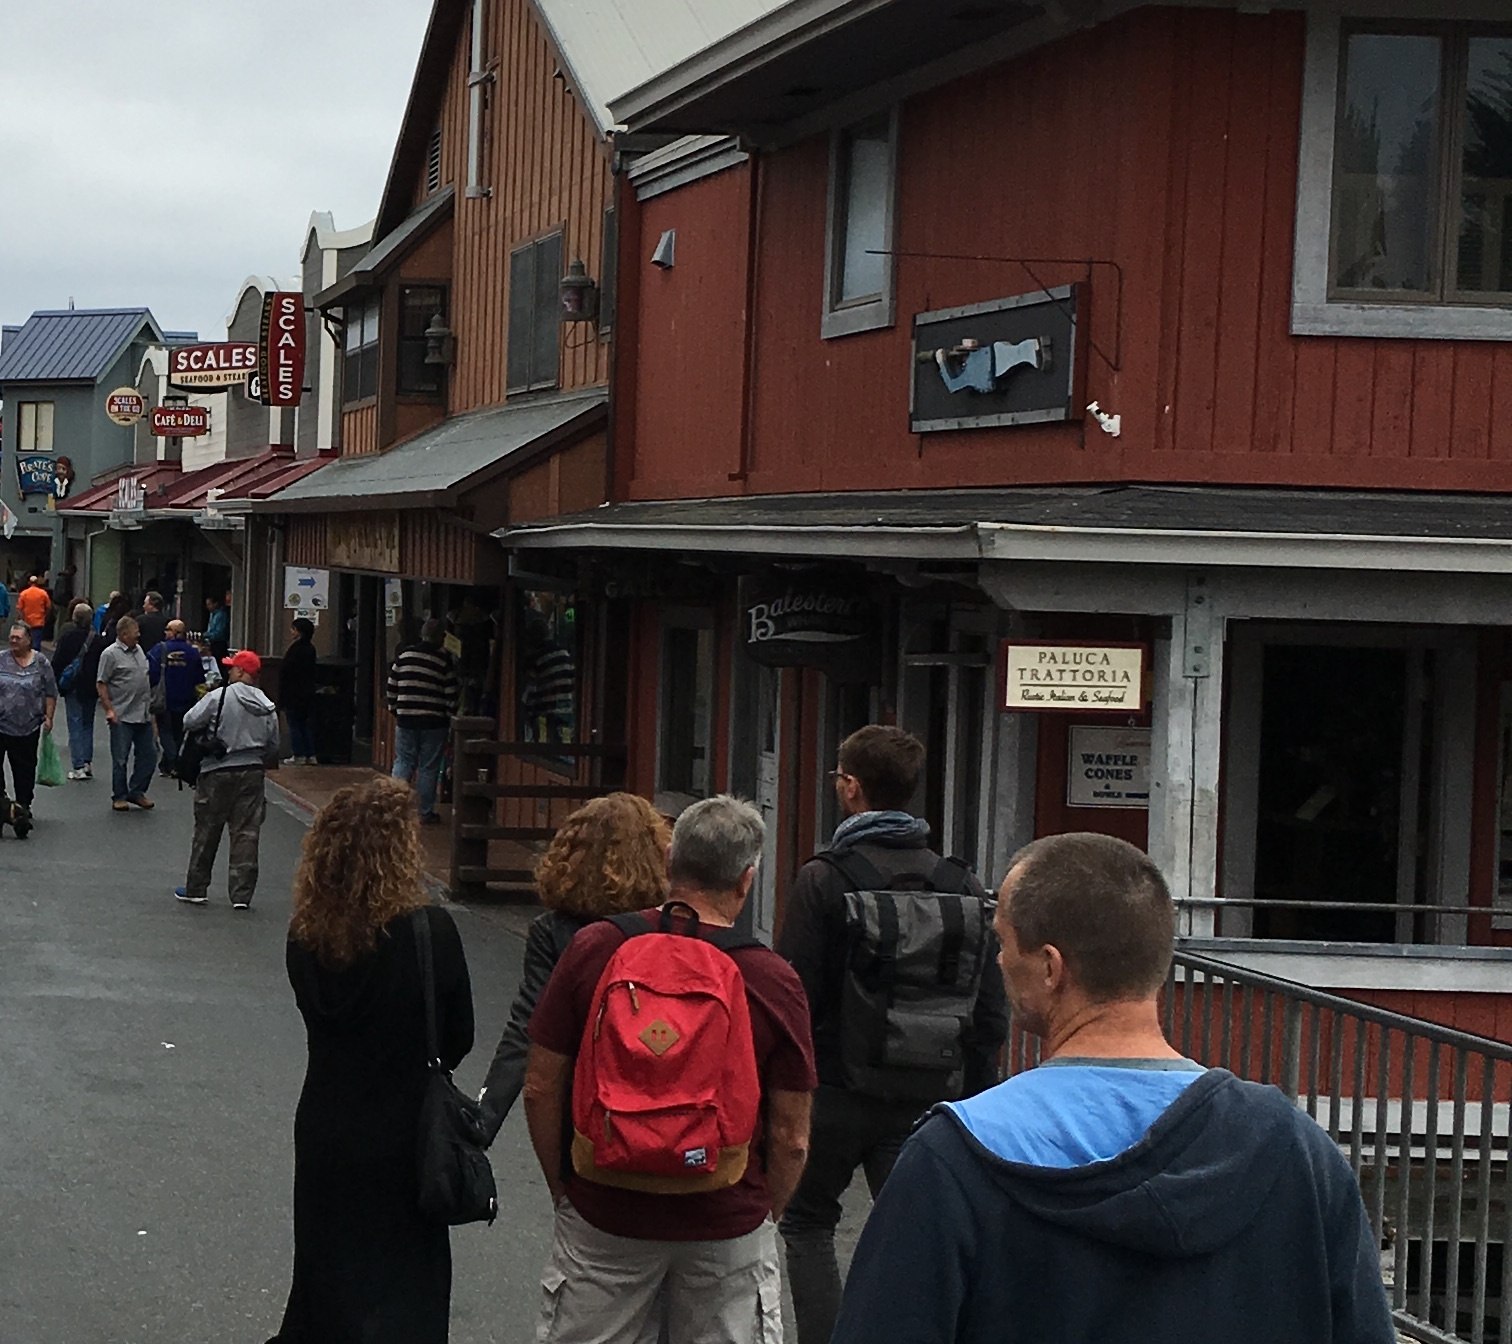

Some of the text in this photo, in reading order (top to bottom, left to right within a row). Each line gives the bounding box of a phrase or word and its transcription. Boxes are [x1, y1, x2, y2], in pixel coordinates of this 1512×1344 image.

[277, 298, 296, 400] SCALES
[177, 347, 256, 370] SCALES
[180, 374, 214, 384] SEAFOOD
[183, 414, 204, 426] DELI
[1038, 651, 1111, 666] PALUCA
[1017, 668, 1131, 683] TRATTORIA
[1078, 691, 1088, 702] &
[1081, 753, 1138, 766] WAFFLE
[1084, 767, 1133, 780] CONES
